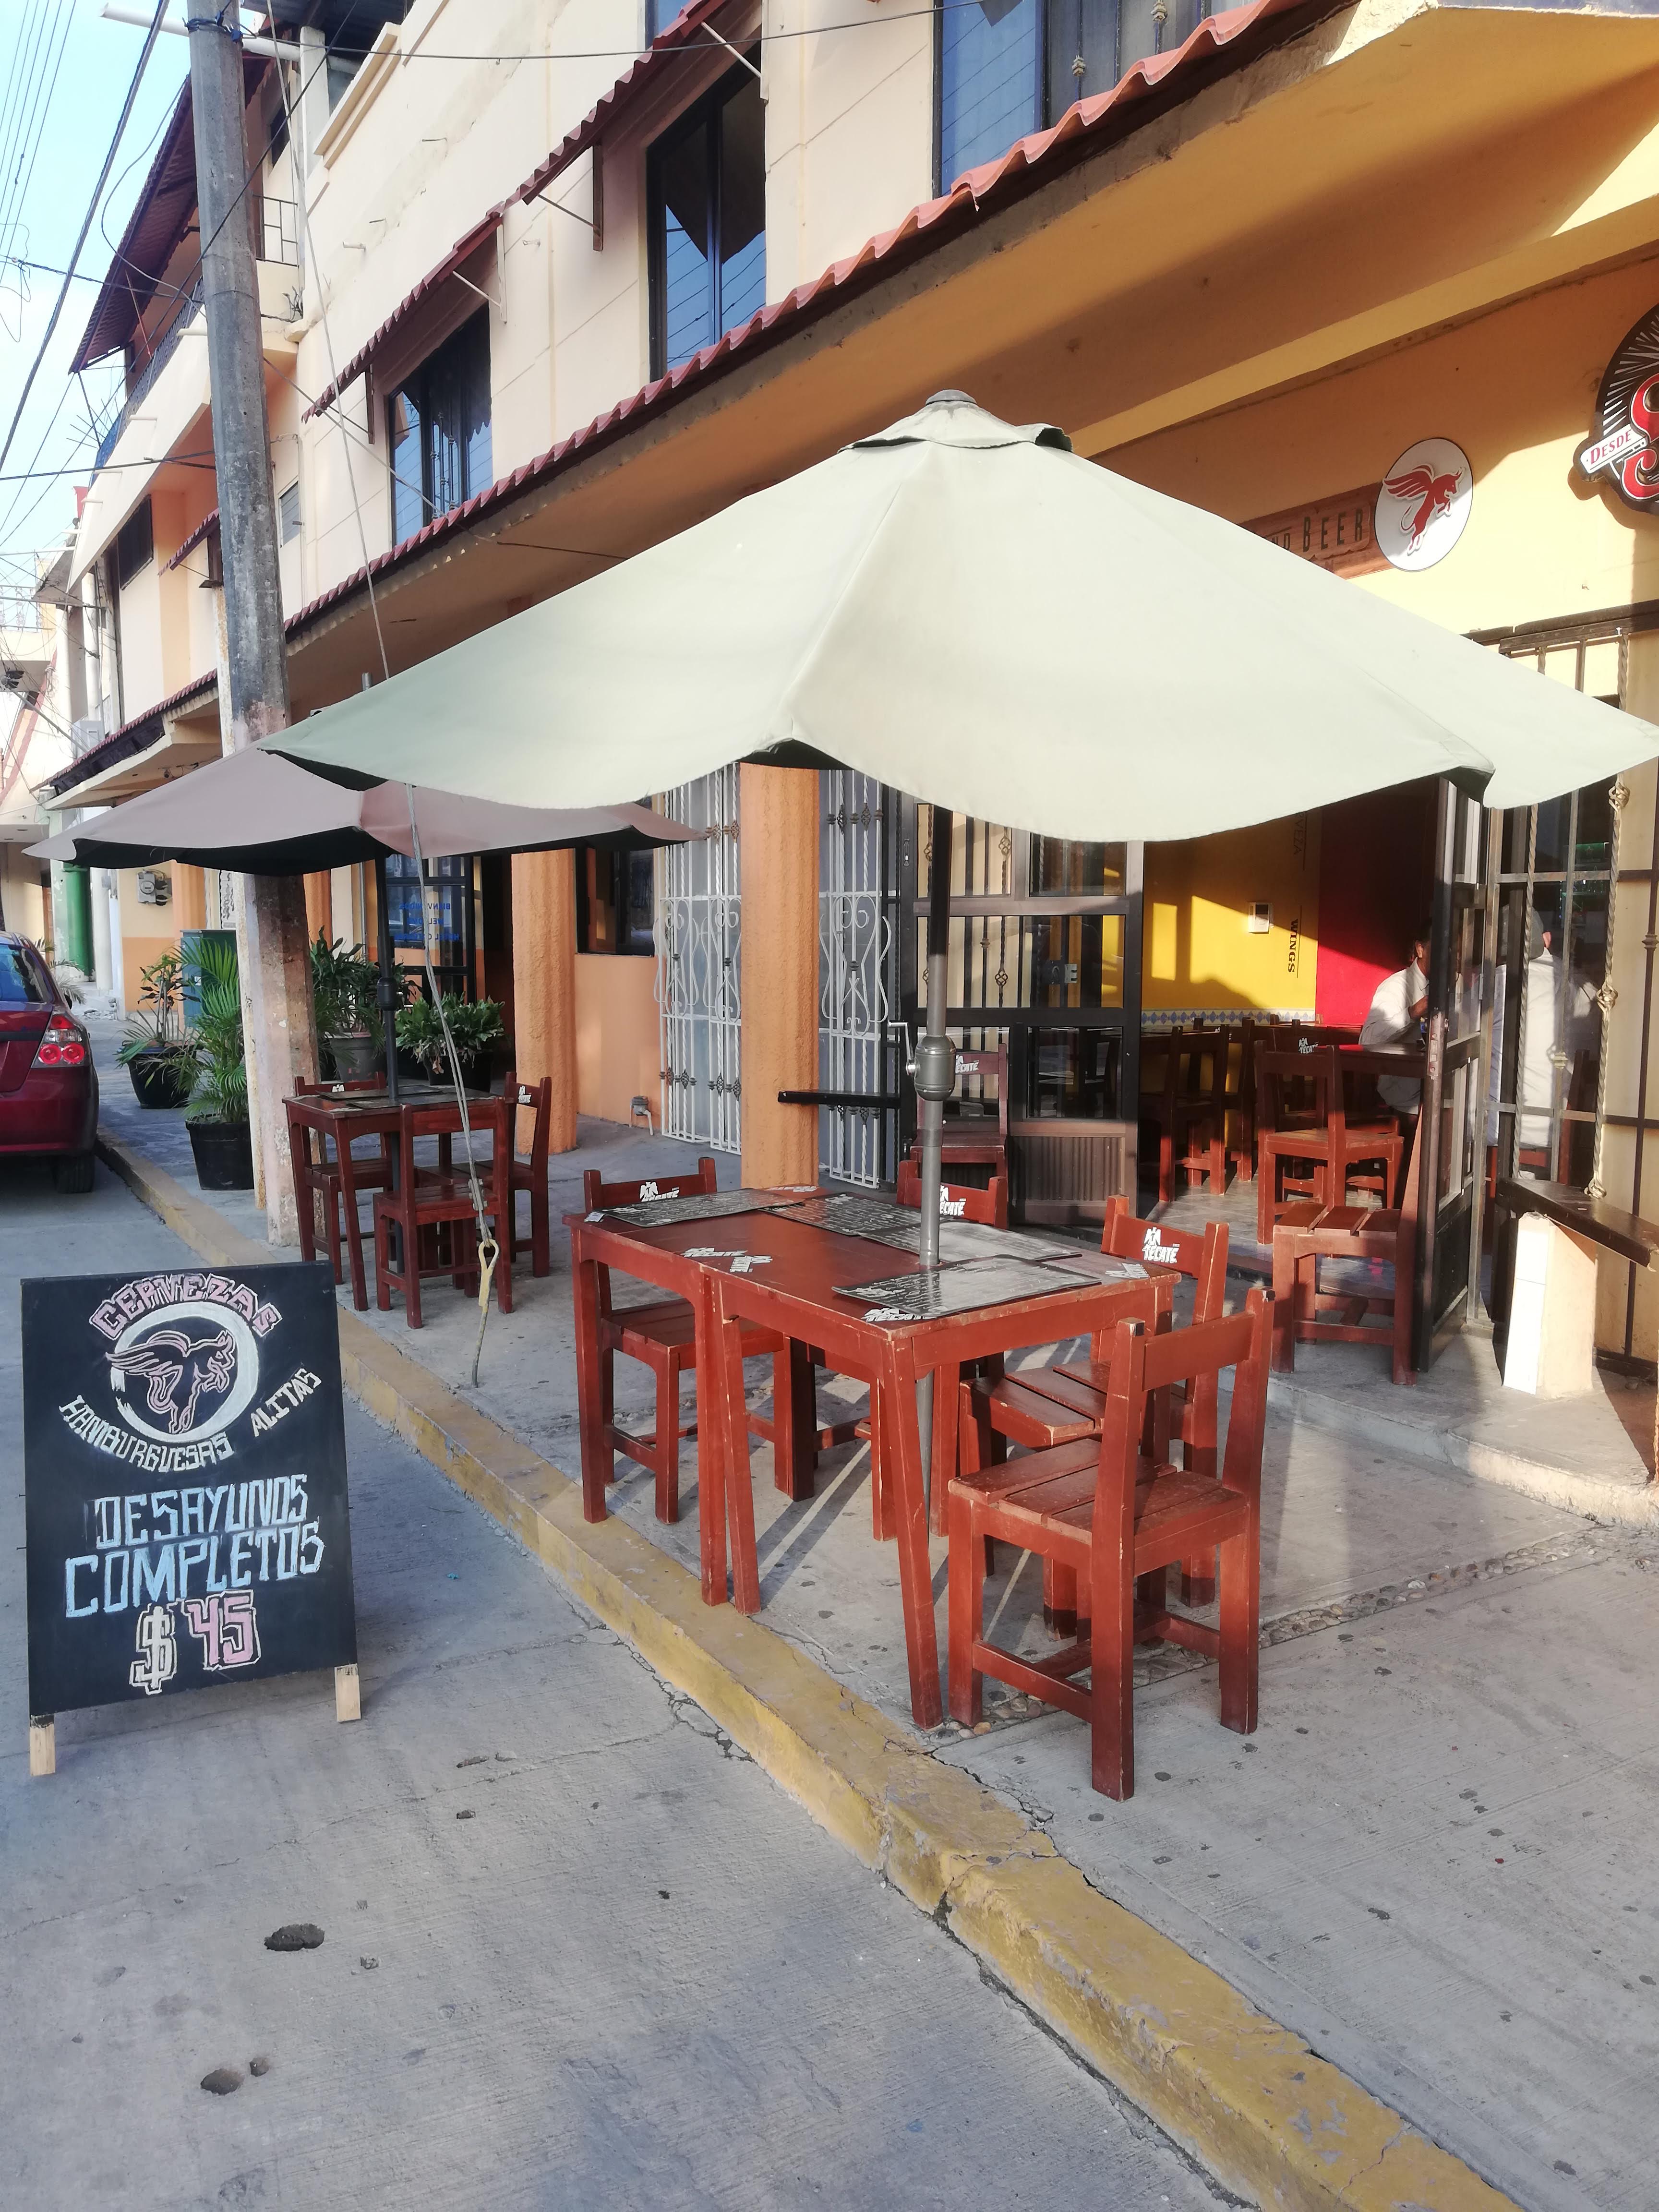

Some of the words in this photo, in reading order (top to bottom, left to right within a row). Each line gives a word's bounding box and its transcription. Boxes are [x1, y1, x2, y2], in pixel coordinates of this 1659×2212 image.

[1590, 430, 1632, 465] DESDE
[1303, 508, 1363, 552] BEER
[1288, 918, 1298, 973] WINGS
[955, 1062, 979, 1073] ECATE
[939, 1202, 966, 1216] ECATE
[1142, 1246, 1179, 1263] TECATE
[89, 1273, 283, 1340] CERVEZAS
[249, 1368, 322, 1437] ALITAS
[59, 1395, 235, 1473] HAMBURGUESAS
[95, 1474, 308, 1549] DESAYUNOS
[65, 1515, 325, 1618] COMPLETOS
